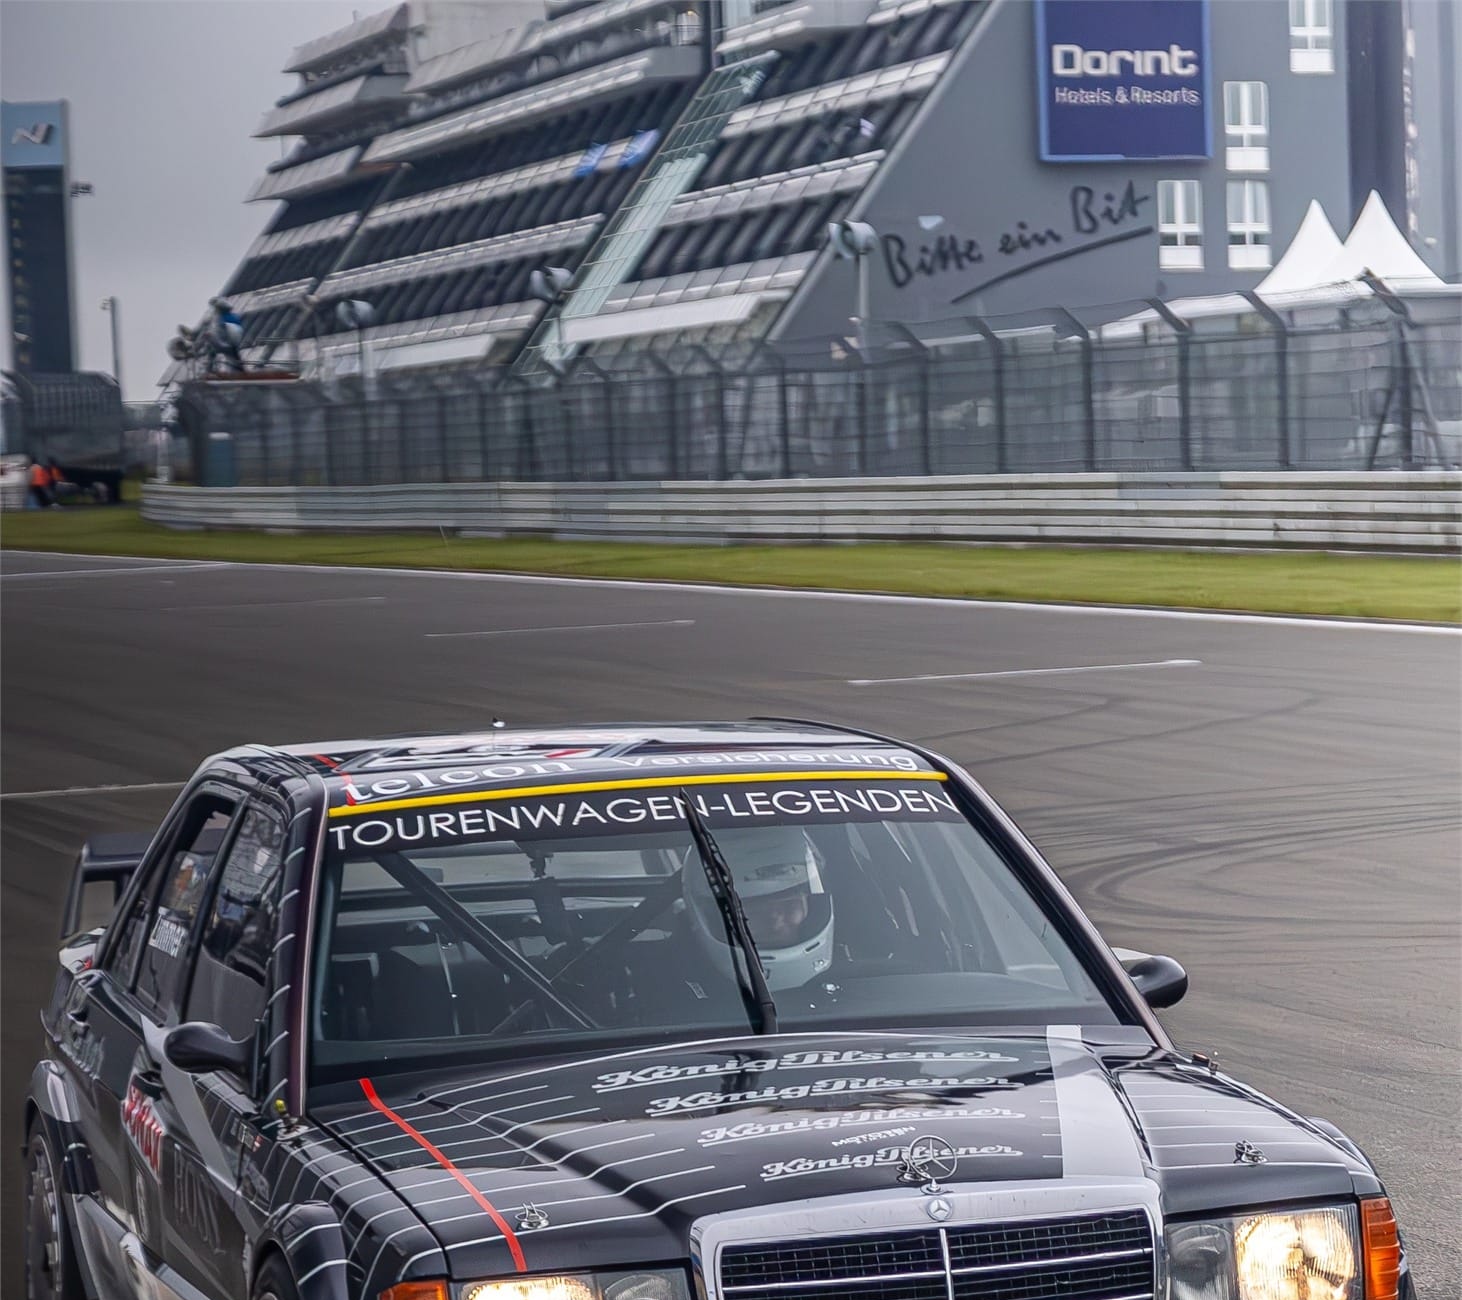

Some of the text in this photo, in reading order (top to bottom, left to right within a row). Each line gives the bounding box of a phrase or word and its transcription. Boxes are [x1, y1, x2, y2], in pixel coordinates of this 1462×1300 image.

[1052, 44, 1199, 77] Dorint
[1055, 86, 1201, 105] Hotels & Resorts
[880, 180, 1150, 288] Bitte ein Bit
[341, 760, 576, 802] telcon
